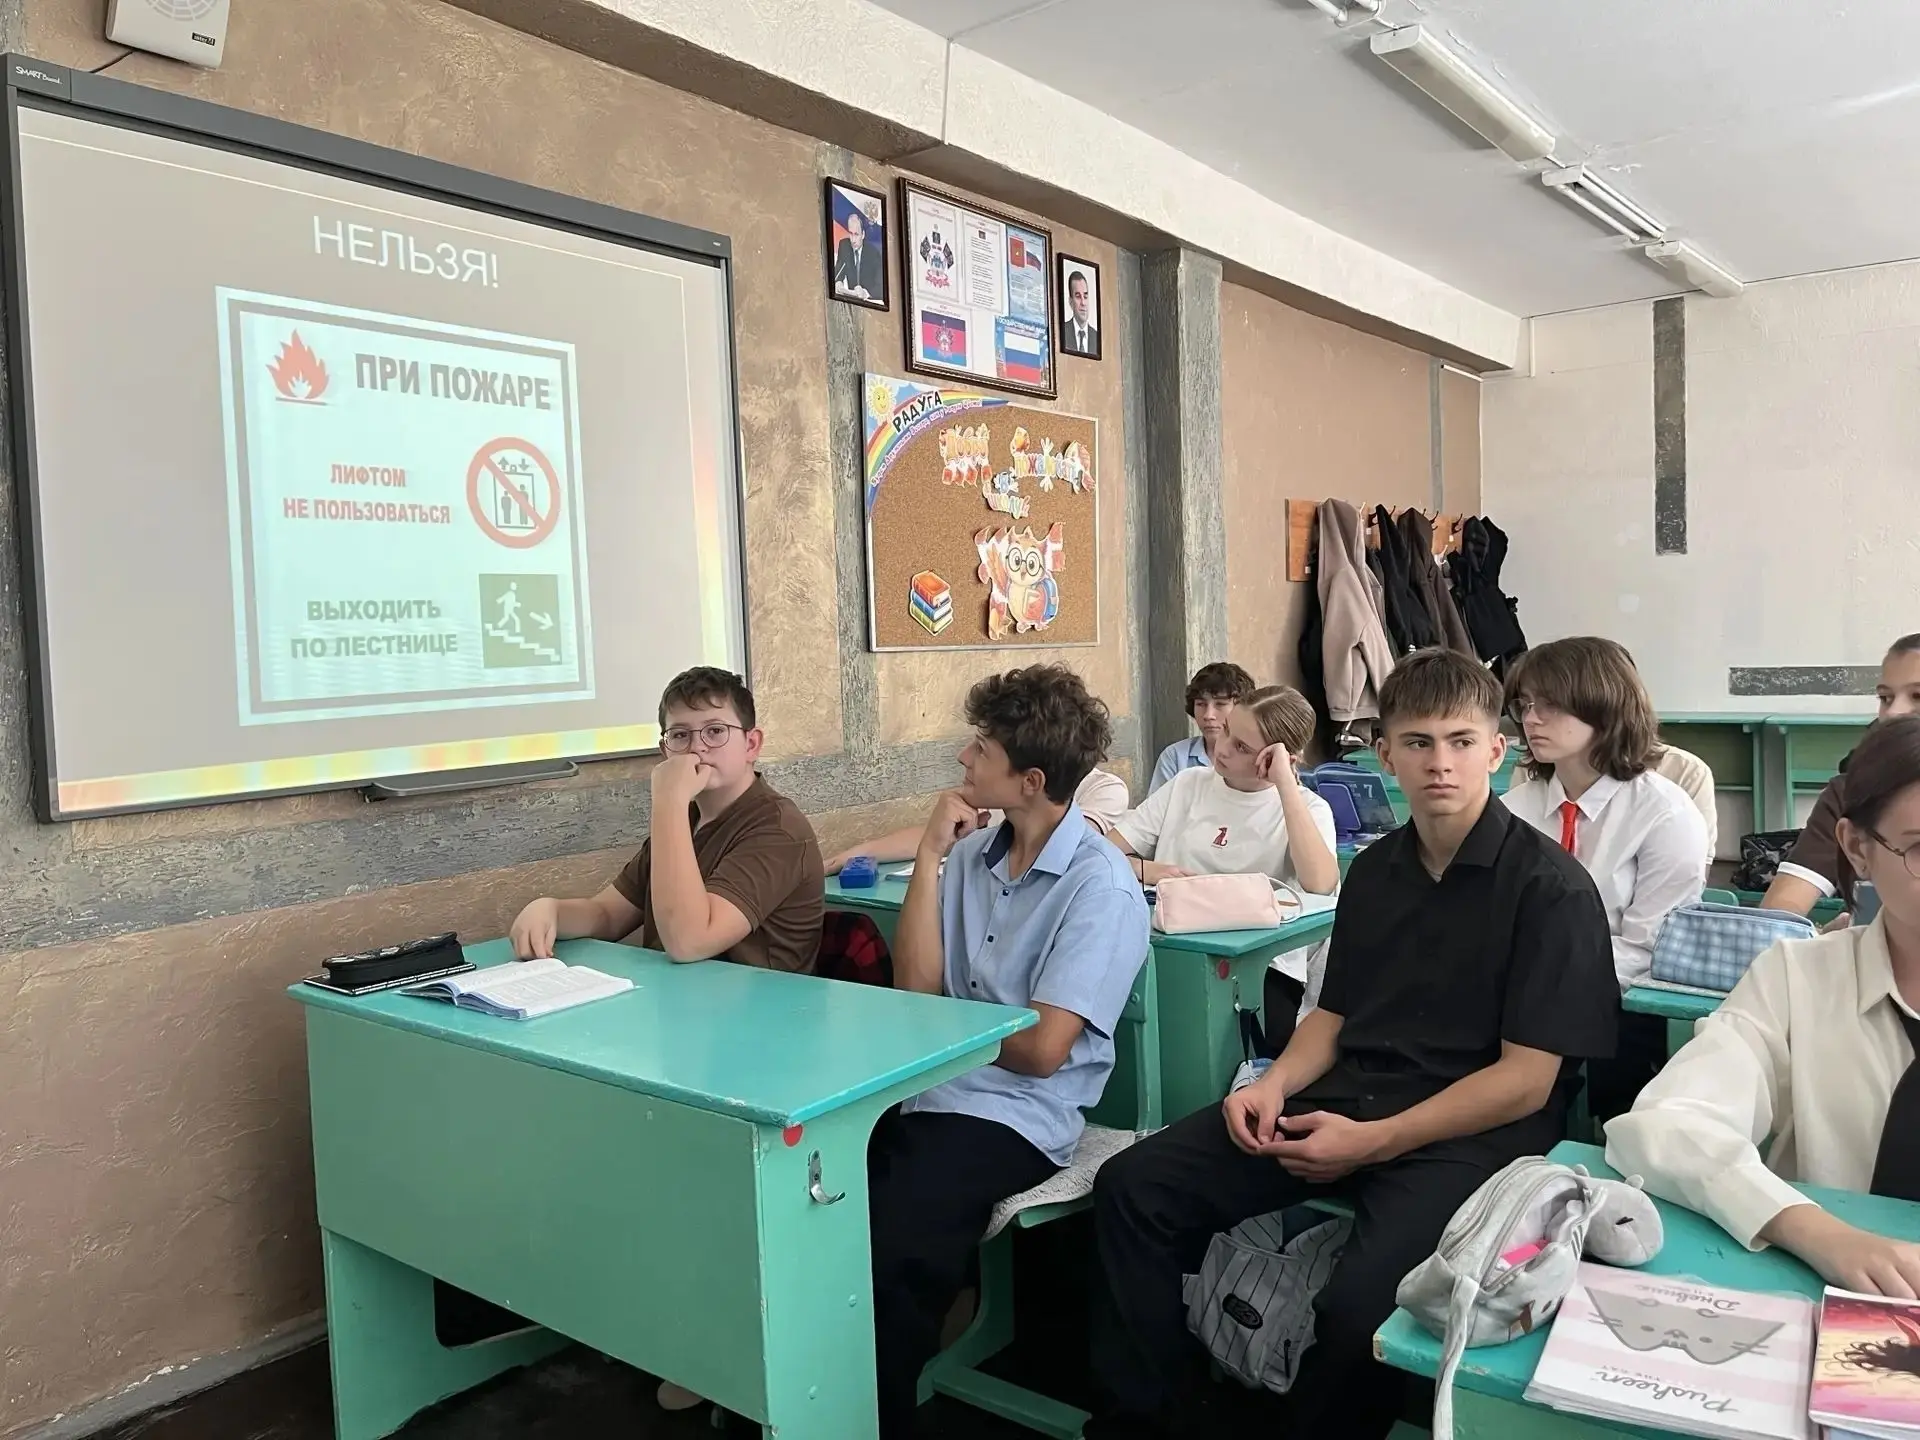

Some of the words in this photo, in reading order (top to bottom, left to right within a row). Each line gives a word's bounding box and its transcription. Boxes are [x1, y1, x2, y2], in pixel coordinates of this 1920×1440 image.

[313, 215, 499, 288] НЕЛЬЗЯ!
[355, 353, 420, 395] ПРИ
[430, 363, 551, 410] ПОЖАРЕ
[892, 391, 943, 433] РАДУГА
[330, 464, 406, 488] ЛИФТОМ
[283, 498, 309, 519] НЕ
[314, 499, 450, 524] ПОЛЬЗОВАТЬСЯ
[307, 599, 441, 624] ВЫХОДИТЬ
[291, 638, 327, 659] ПО
[334, 634, 458, 657] ЛЕСТНИЦЕ
[1363, 784, 1373, 799] 7
[1596, 1371, 1739, 1413] Pusheen
